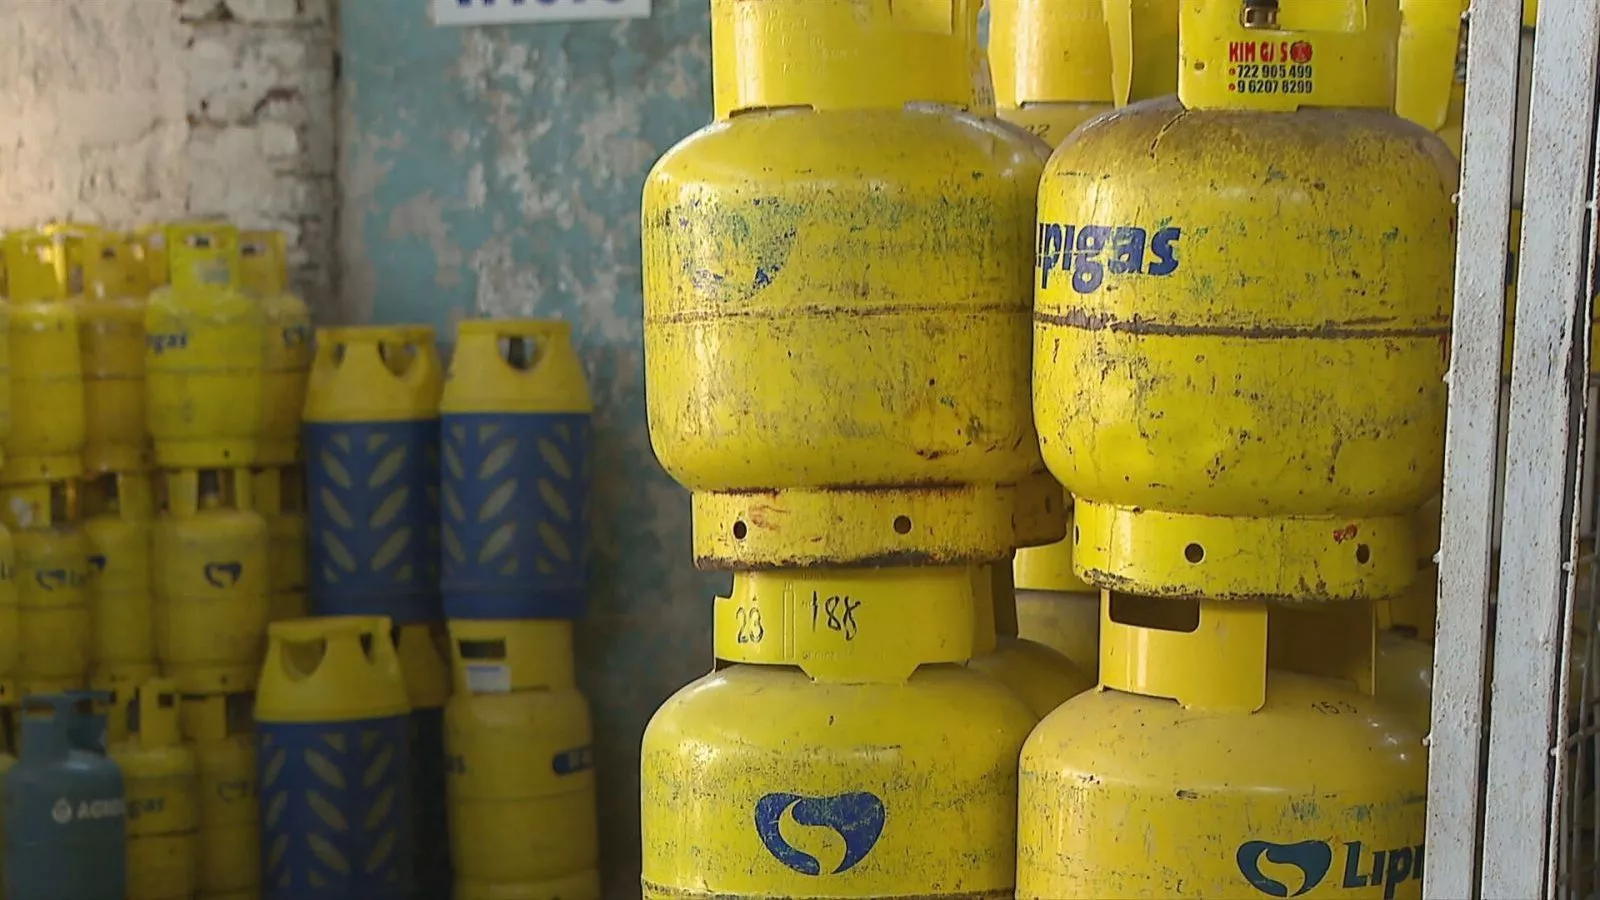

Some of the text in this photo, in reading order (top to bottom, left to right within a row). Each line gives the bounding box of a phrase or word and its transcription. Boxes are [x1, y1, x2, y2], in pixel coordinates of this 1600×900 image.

[1229, 42, 1255, 62] KIM
[1237, 65, 1312, 78] 722 905 499
[1237, 81, 1245, 93] 9
